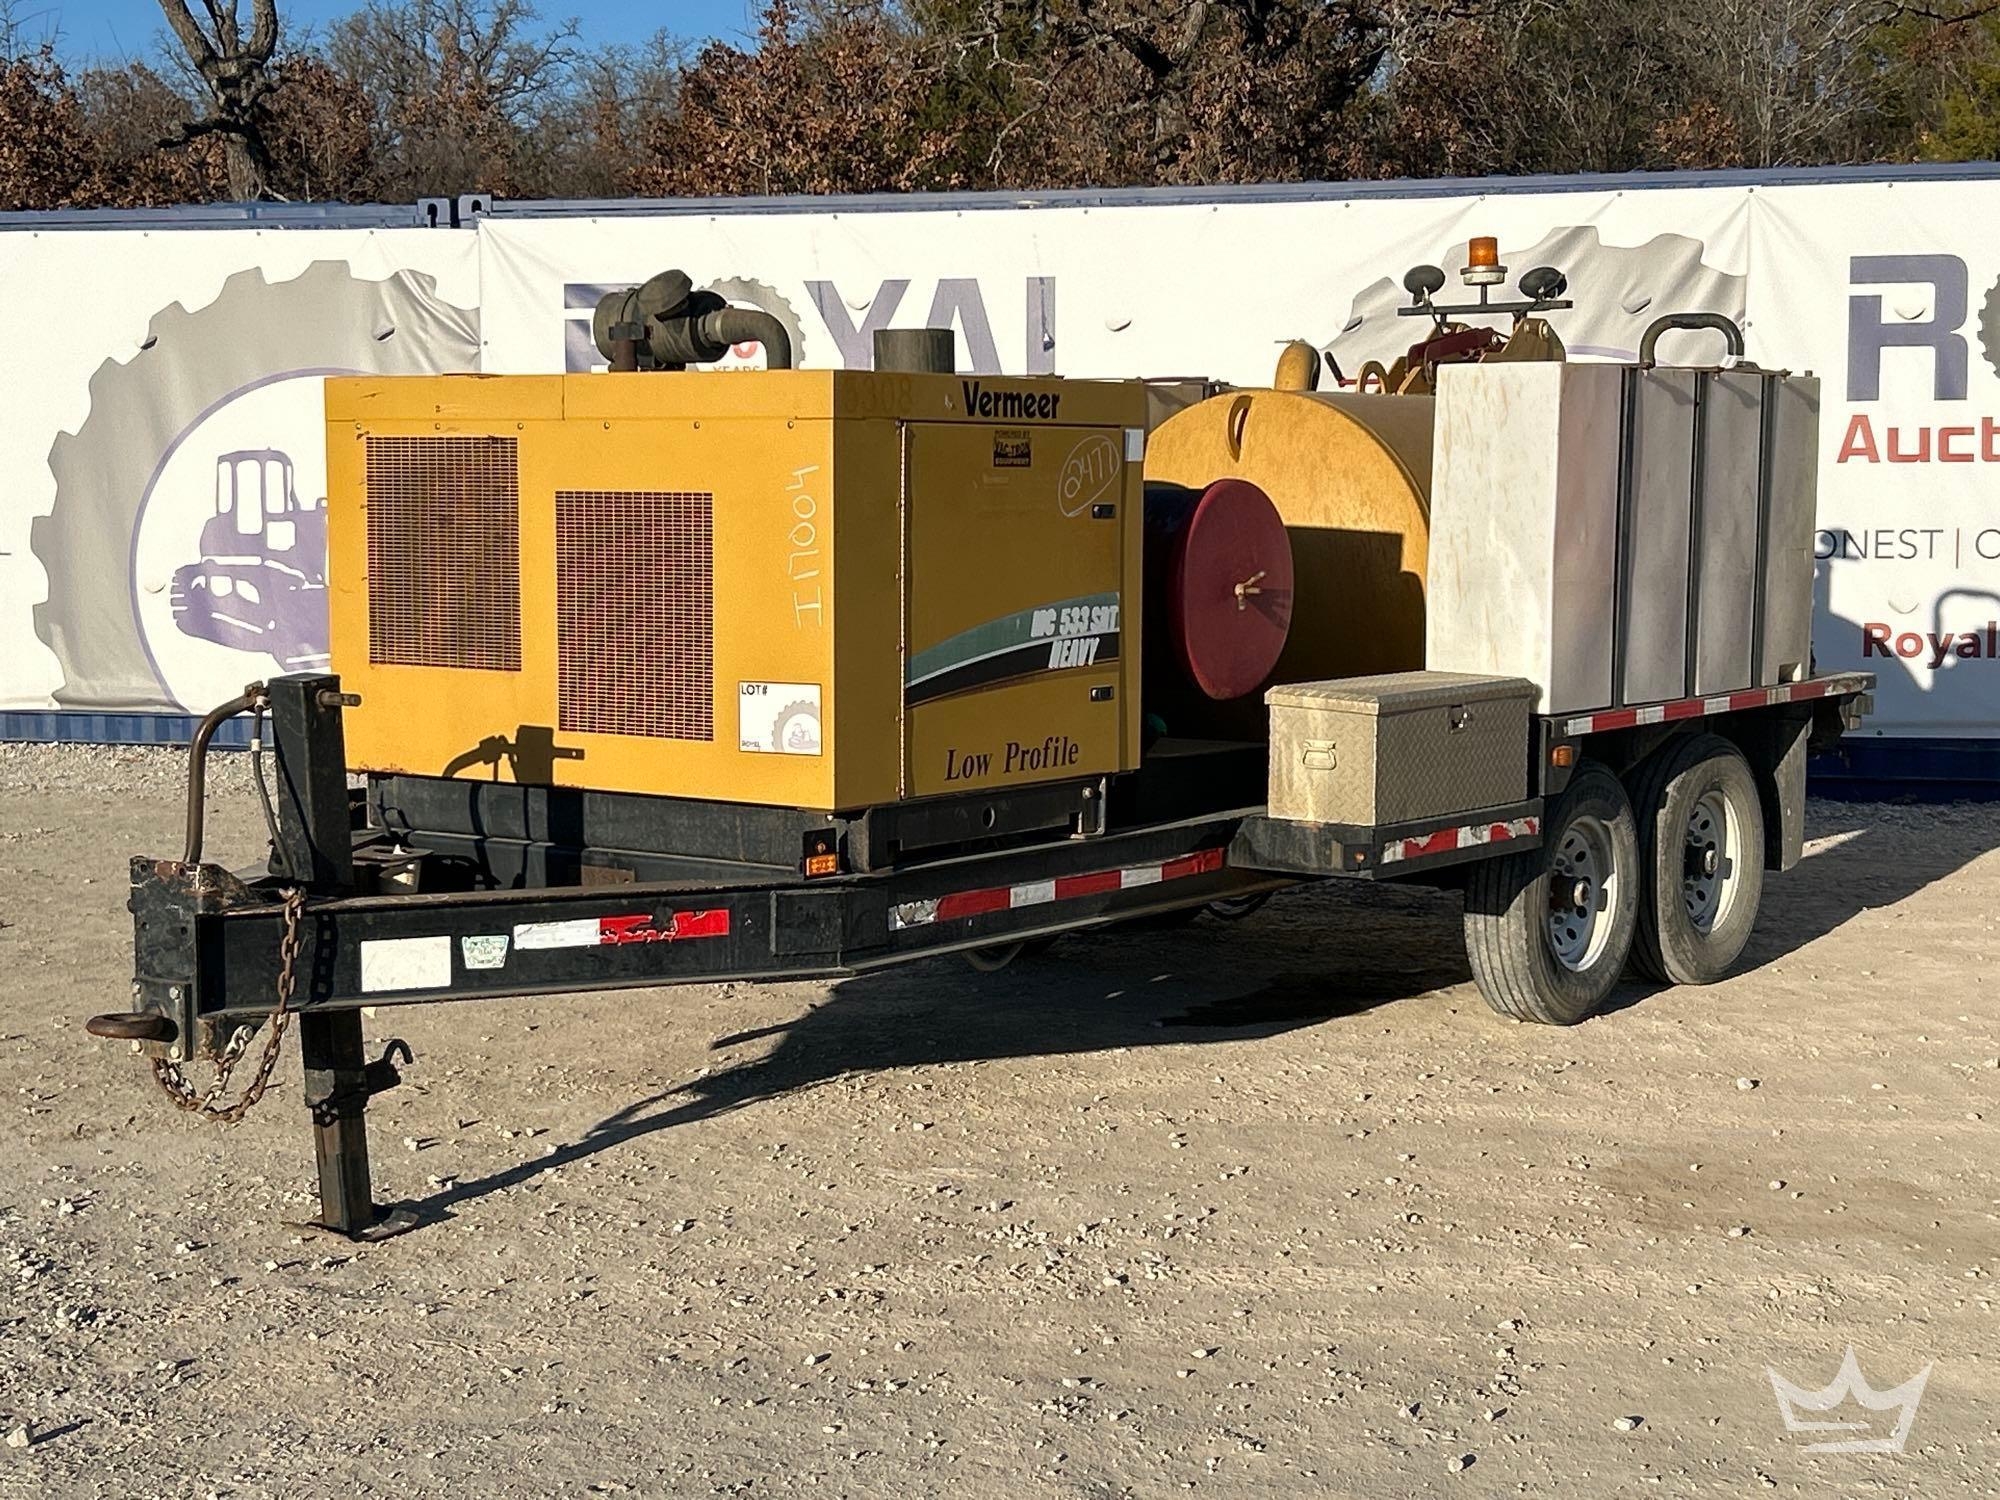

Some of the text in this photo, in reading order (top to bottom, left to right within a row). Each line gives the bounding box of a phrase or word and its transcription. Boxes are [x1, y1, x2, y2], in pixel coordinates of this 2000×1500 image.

[962, 381, 1060, 419] Vermeer
[1048, 638, 1100, 669] HEAVY
[1863, 621, 2000, 669] Royal
[944, 736, 1078, 781] Low Profile
